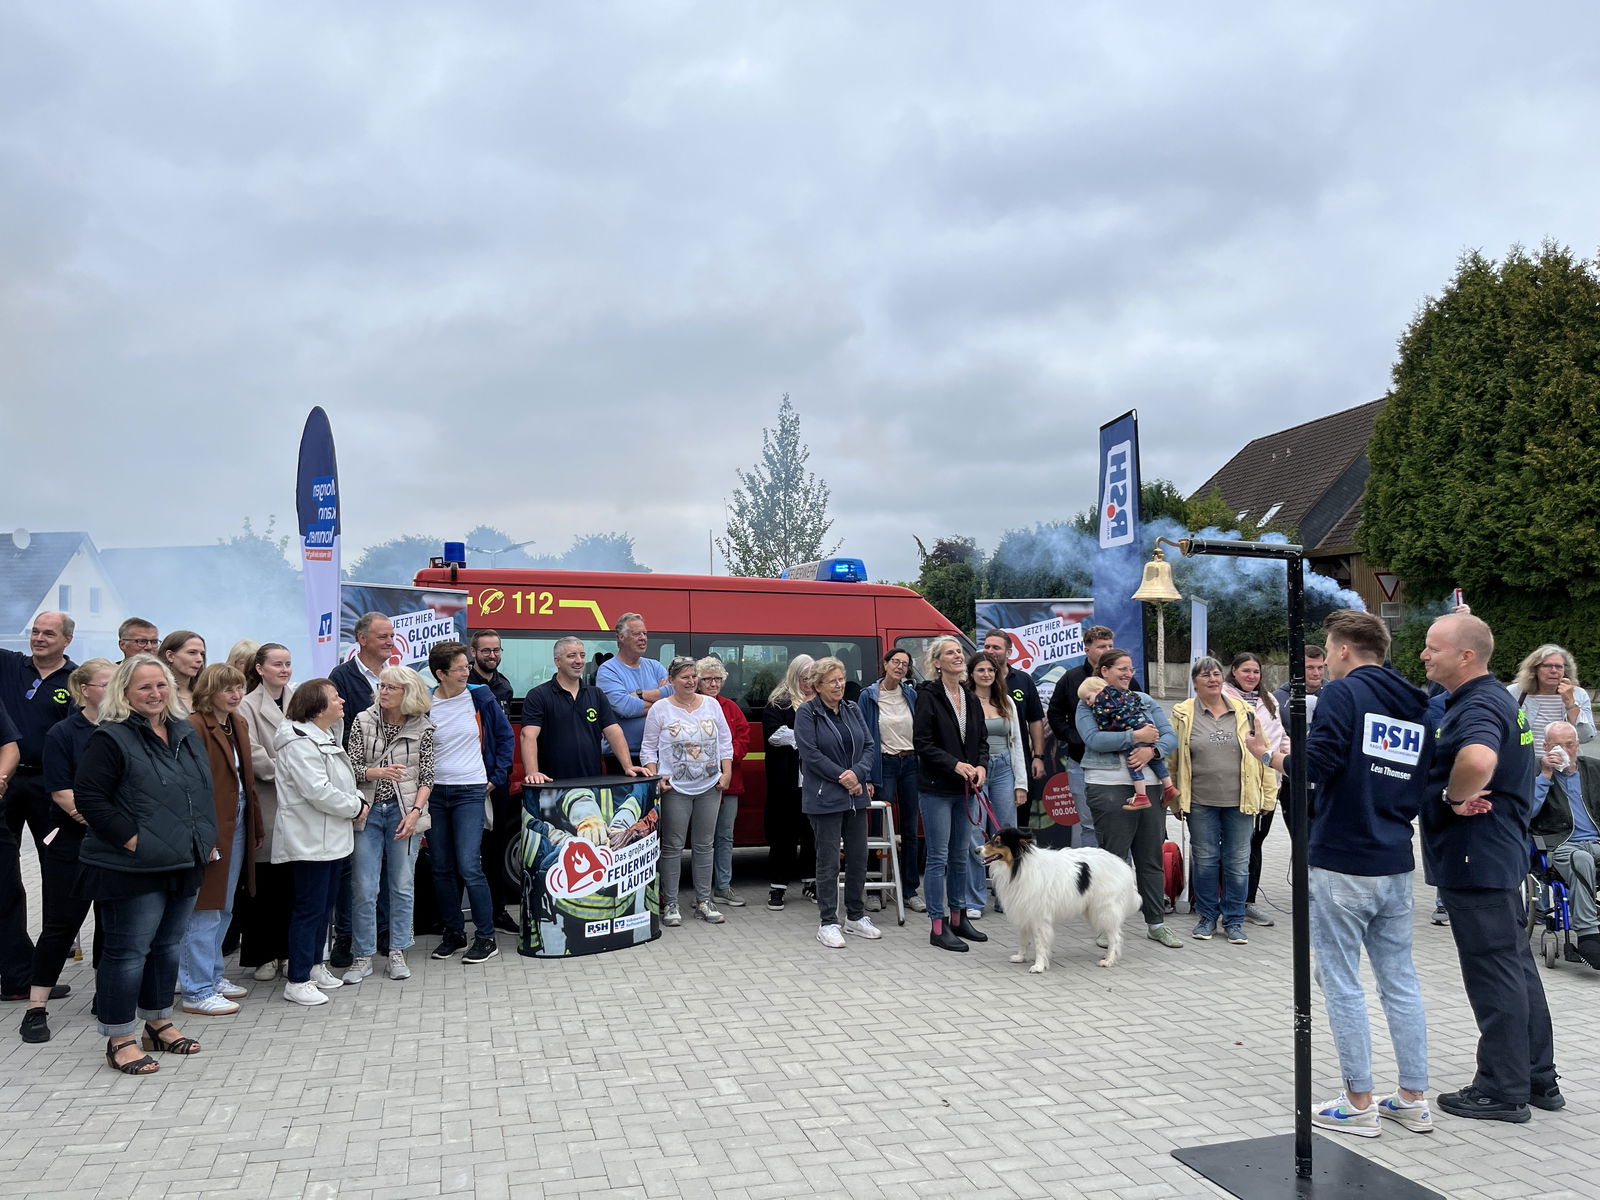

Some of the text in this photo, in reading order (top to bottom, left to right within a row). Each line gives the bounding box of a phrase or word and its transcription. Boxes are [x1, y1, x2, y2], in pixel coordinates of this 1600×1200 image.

[512, 591, 554, 615] 112
[392, 612, 433, 629] JETZT HIER
[1023, 620, 1061, 637] JETZT HIER
[408, 622, 451, 643] GLOCKE
[1038, 627, 1079, 647] GLOCKE
[1043, 641, 1084, 661] LÄUTEN
[1383, 766, 1411, 780] Thomsen
[614, 852, 627, 863] Das
[627, 842, 645, 858] große
[621, 864, 654, 893] LÄUTEN
